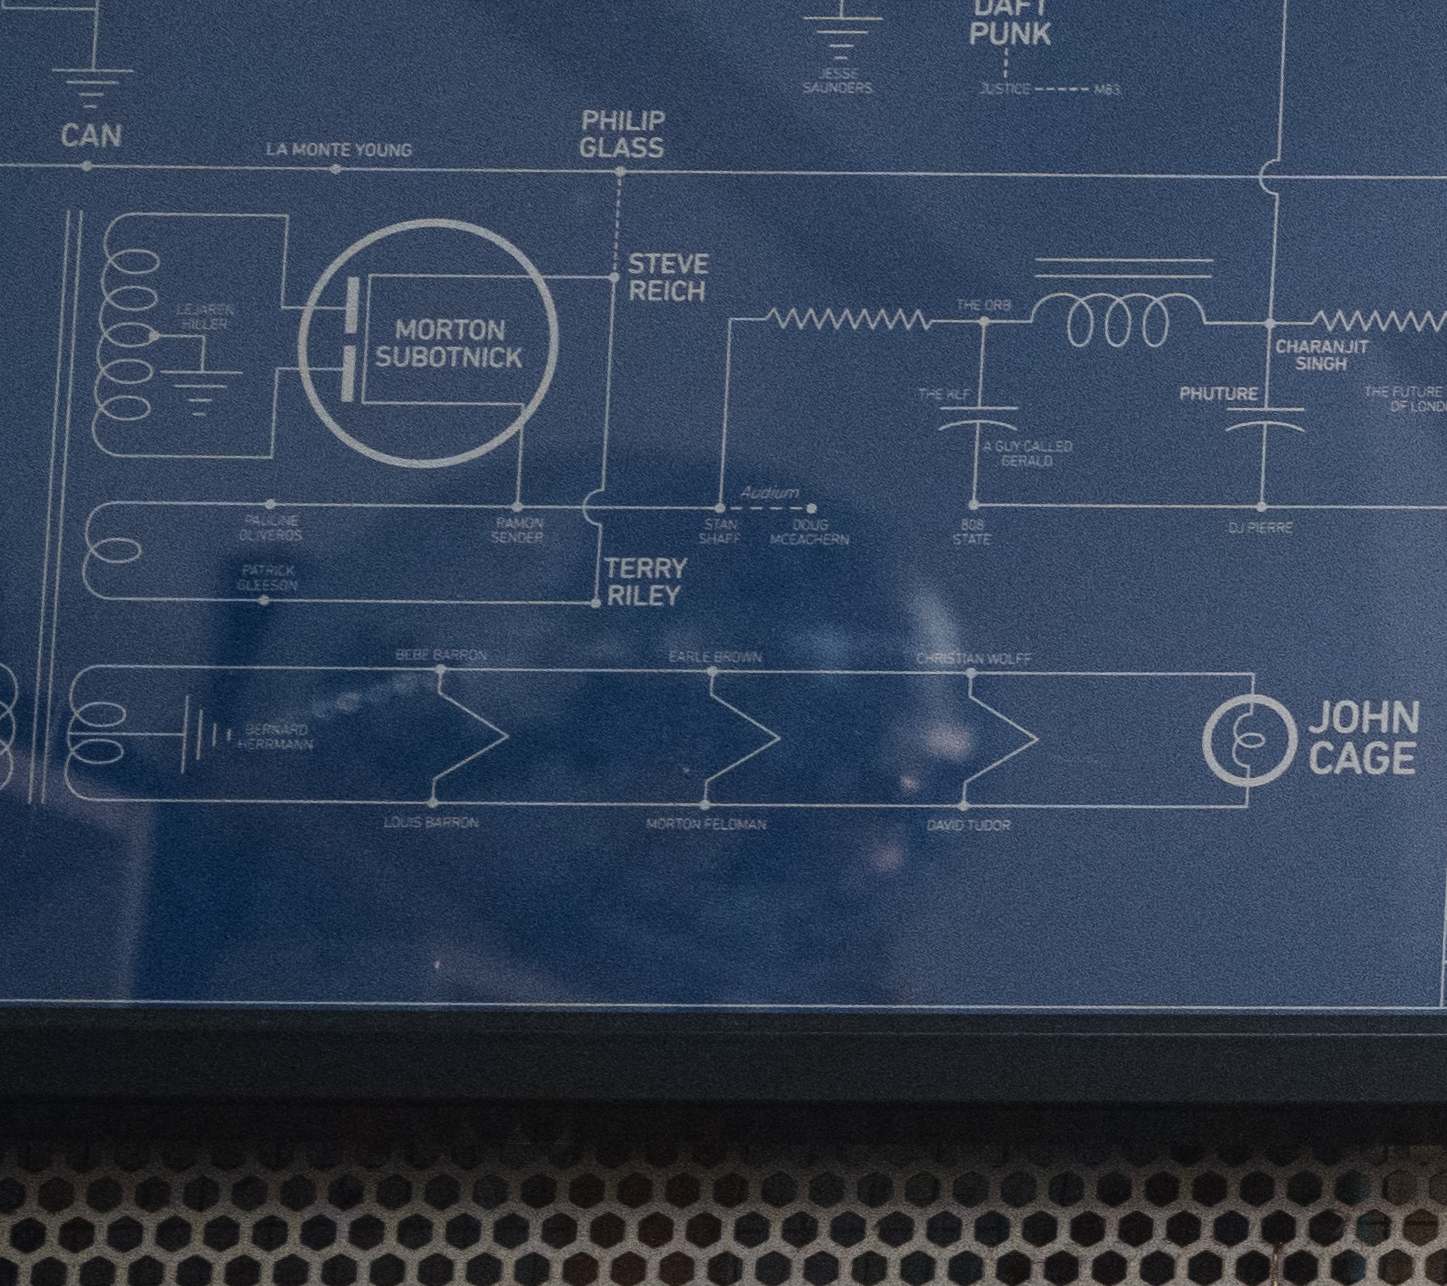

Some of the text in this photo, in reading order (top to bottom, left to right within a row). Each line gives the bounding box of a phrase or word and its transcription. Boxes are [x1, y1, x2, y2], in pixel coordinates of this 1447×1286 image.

[970, 21, 1052, 46] PUNK
[818, 67, 859, 80] JESSE
[802, 81, 873, 94] SAUNDERS
[979, 82, 1031, 95] JUSTICE
[582, 110, 666, 131] PHILIP
[61, 124, 122, 147] CAN
[267, 143, 413, 157] LA MONTE YOUNG
[580, 137, 664, 158] GLASS
[628, 253, 709, 274] STEVE
[629, 280, 706, 301] REICH
[396, 319, 505, 340] MORTON
[1276, 339, 1370, 354] CHARANJIT
[375, 346, 522, 368] SUBOTNICK
[1295, 356, 1349, 371] SINGH
[1180, 386, 1259, 401] PHUTURE
[1365, 385, 1391, 398] THE
[1395, 386, 1443, 398] FUTURE
[1391, 401, 1408, 413] OF
[1001, 455, 1053, 467] GERALD
[740, 486, 800, 500] Audium
[496, 517, 543, 529] RAMON
[704, 519, 737, 531] STAN
[792, 519, 829, 531] DOUG
[961, 519, 984, 531] 808
[1228, 522, 1293, 535] DJ PIERRE
[491, 531, 543, 544] SENDER
[953, 533, 992, 545] STATE
[605, 557, 688, 579] TERRY
[608, 585, 681, 606] RILEY
[395, 649, 487, 661] BEBE BARRON
[668, 651, 762, 663] EARLE BROWN
[916, 653, 1032, 665] CHRISTIAN WOLFF
[1309, 700, 1419, 734] JOHN
[1308, 741, 1416, 775] CAGE
[384, 817, 479, 828] LOUIS BARRON
[646, 818, 767, 831] MORTON FELDMAN
[927, 818, 1011, 831] DAVID TUDOR
